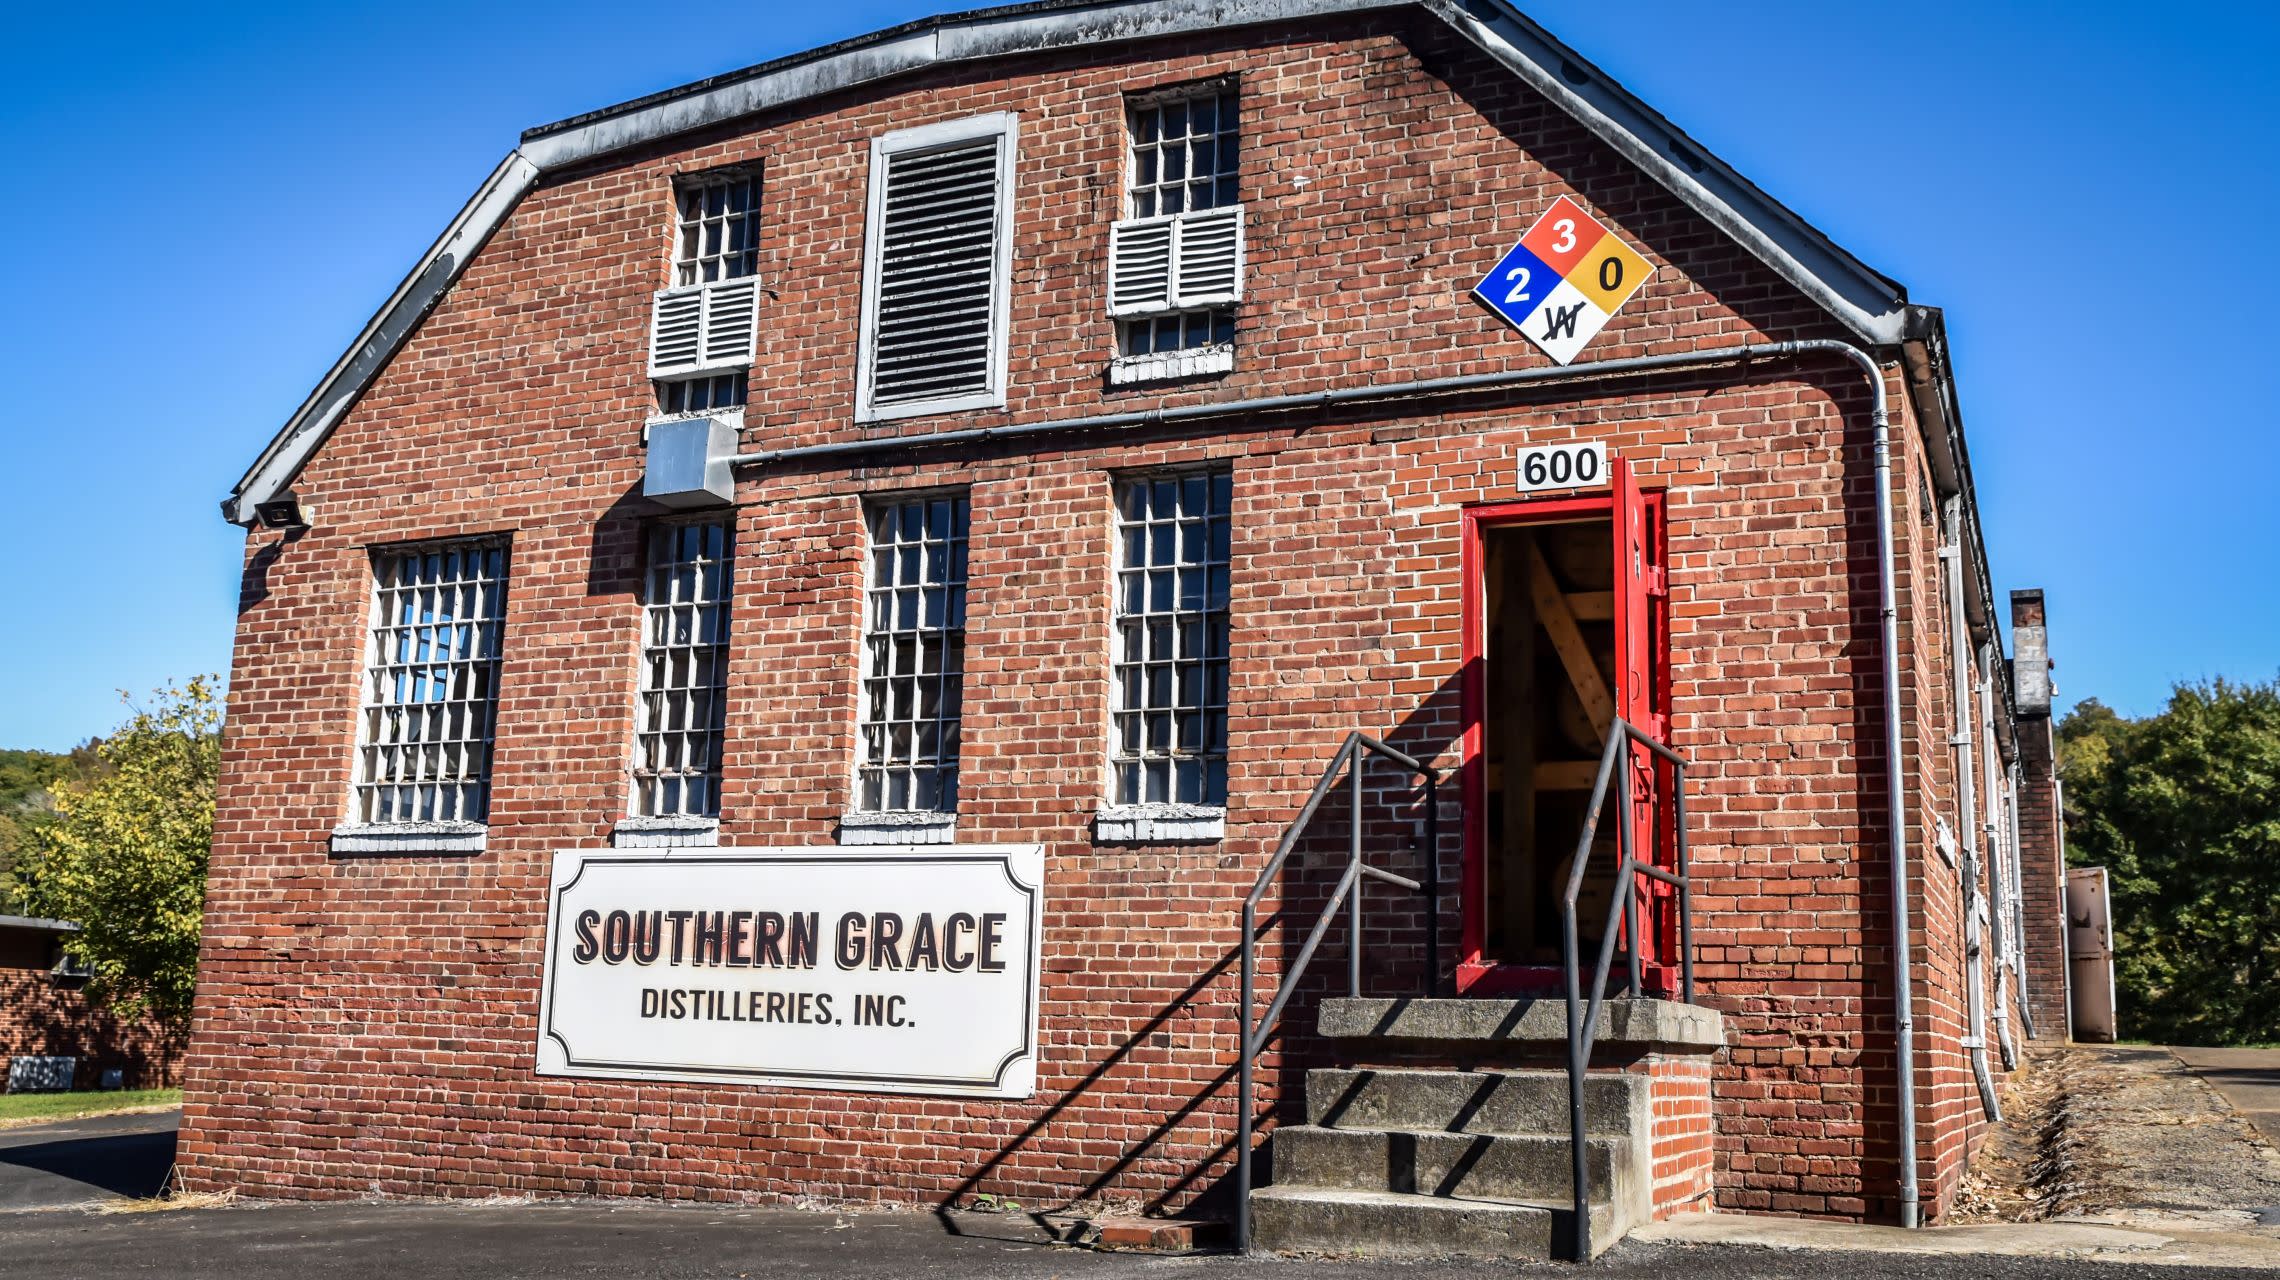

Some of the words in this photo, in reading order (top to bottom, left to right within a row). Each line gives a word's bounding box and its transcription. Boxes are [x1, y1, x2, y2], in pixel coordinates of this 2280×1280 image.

[1551, 218, 1577, 253] 3
[1504, 267, 1531, 304] 2
[1598, 256, 1624, 291] 0
[1523, 447, 1599, 485] 600
[573, 908, 820, 969] SOUTHERN
[835, 911, 1007, 973] GRACE
[640, 988, 842, 1027] DISTILLERIES,
[853, 994, 916, 1027] INC.
